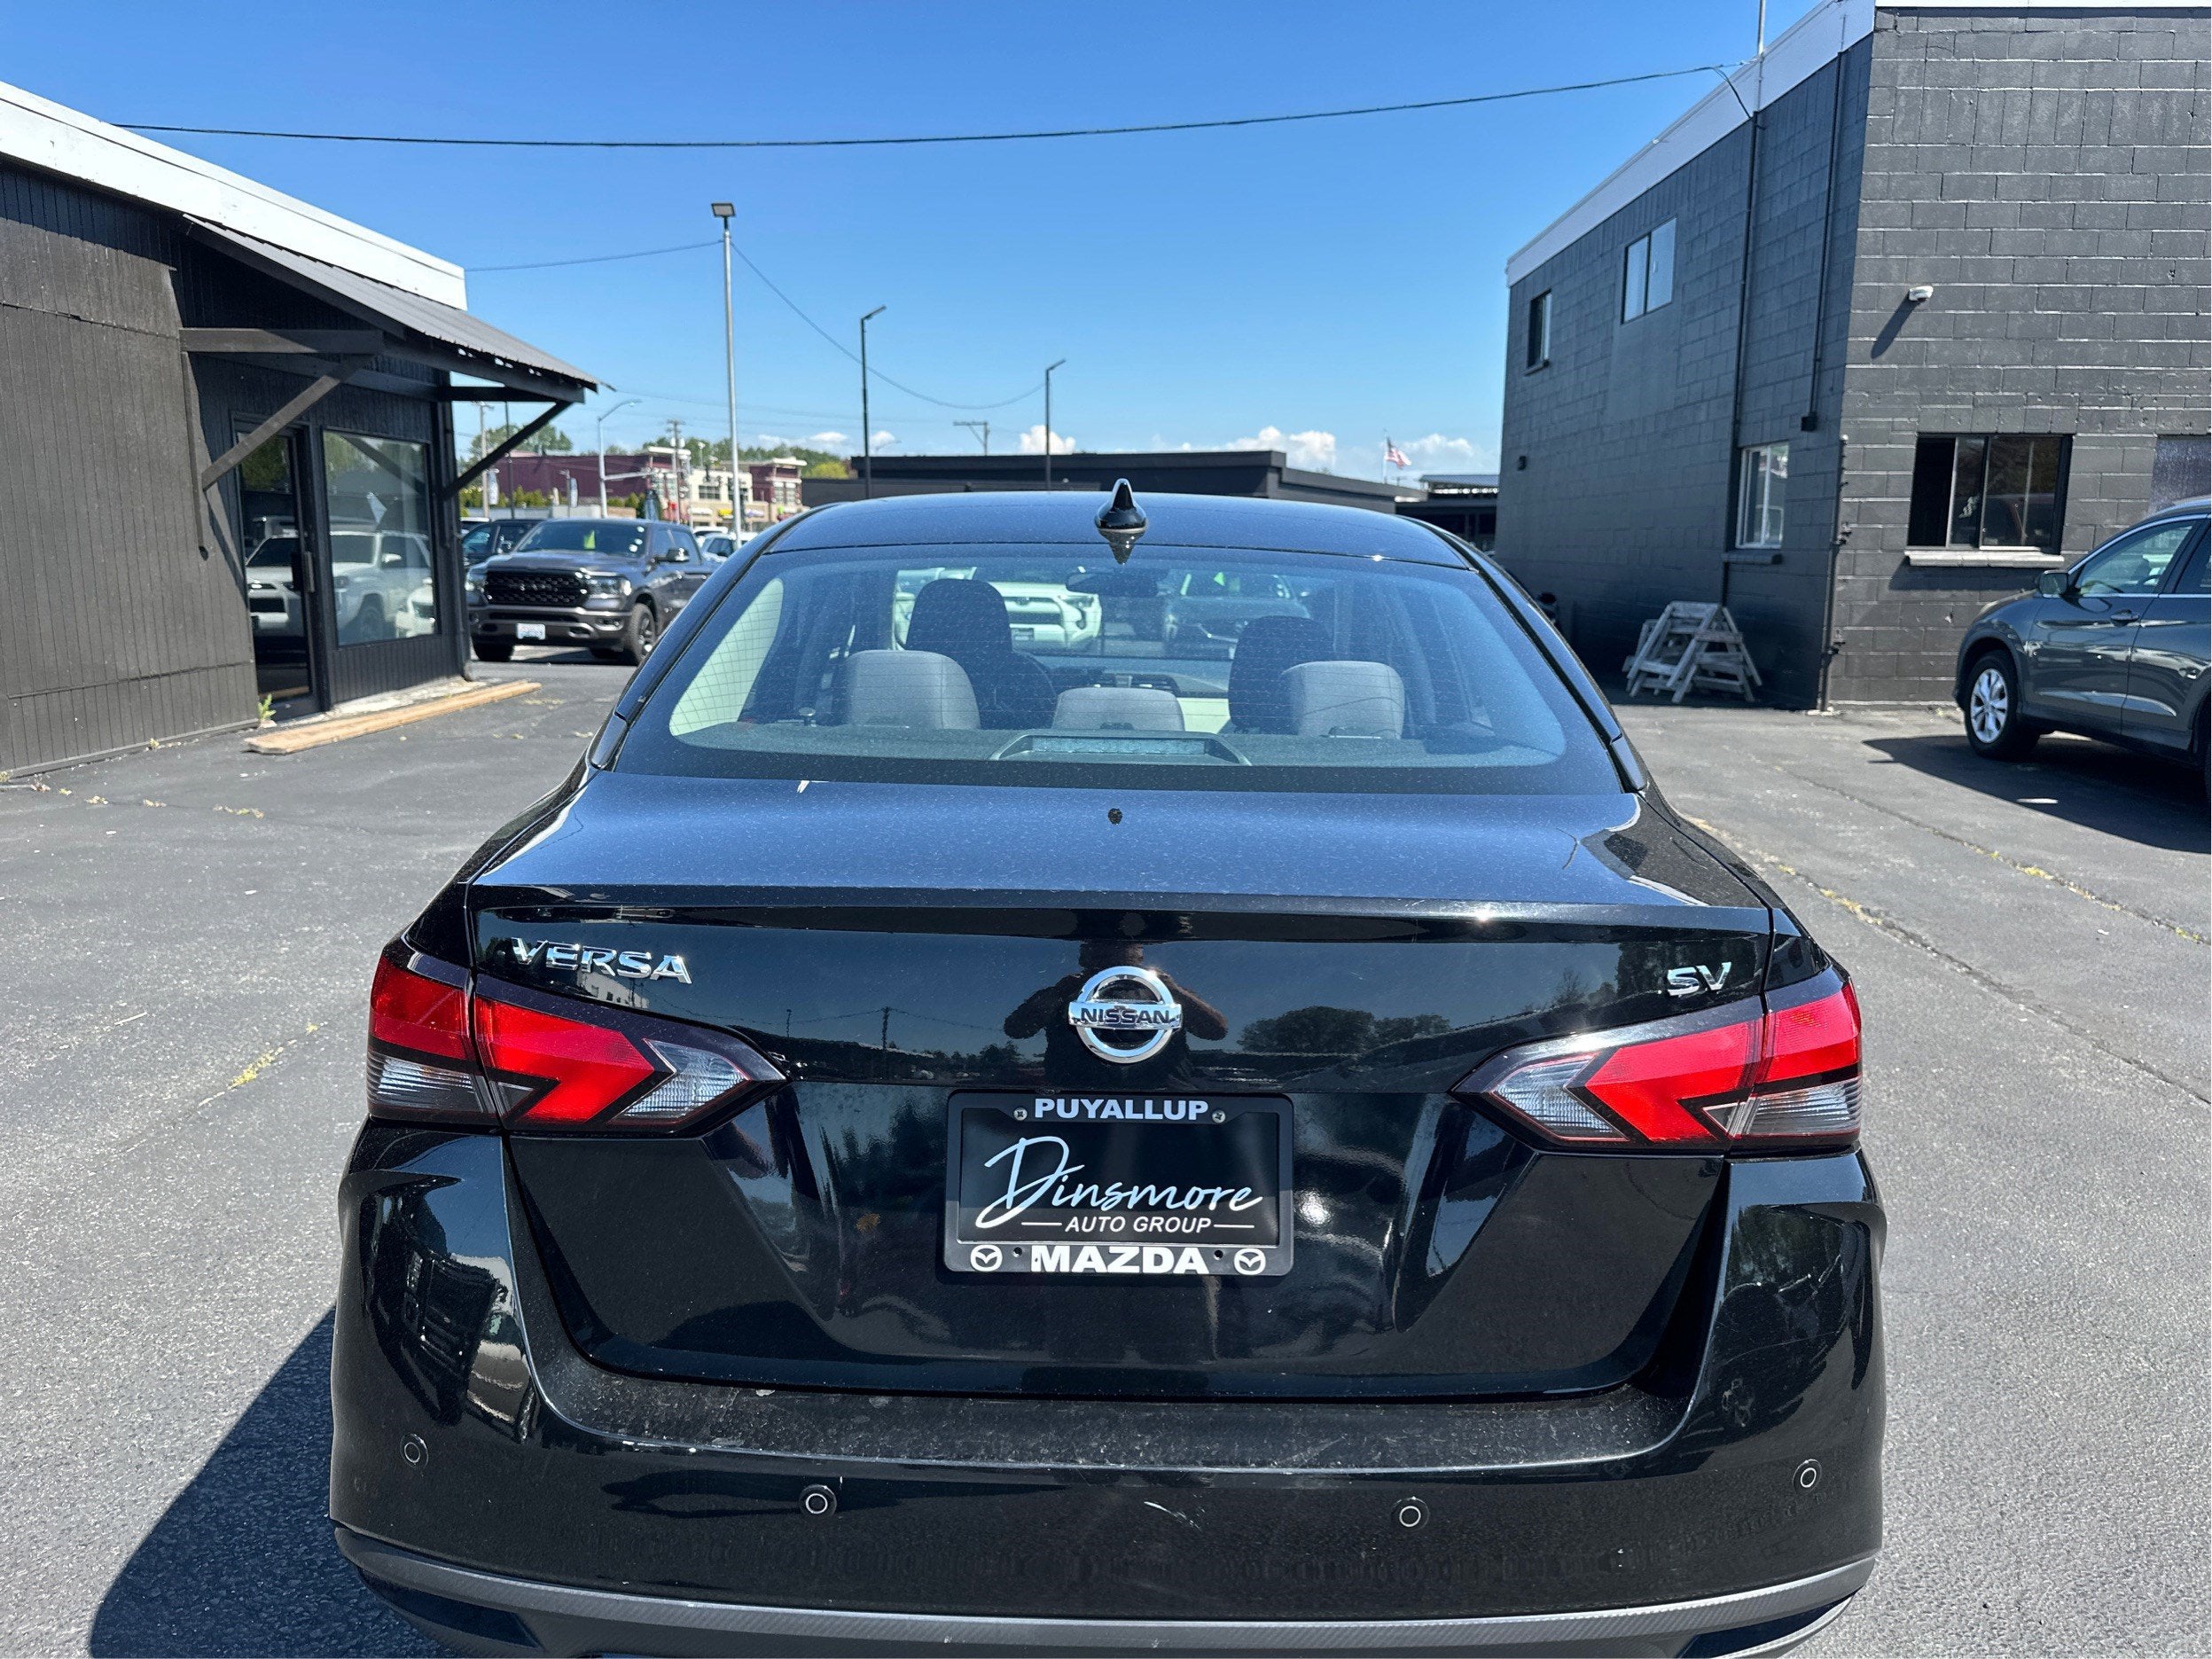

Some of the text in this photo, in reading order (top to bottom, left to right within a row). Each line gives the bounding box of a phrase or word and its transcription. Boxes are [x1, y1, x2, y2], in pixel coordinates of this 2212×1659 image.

[511, 936, 692, 983] VERSA
[1667, 961, 1731, 996] SV
[1080, 1007, 1170, 1025] NISSAN
[1035, 1098, 1208, 1121] PUYALLUP
[975, 1136, 1262, 1229] Dinsmore
[1065, 1216, 1212, 1233] AUTO GROUP
[1030, 1245, 1210, 1274] MAZDA
